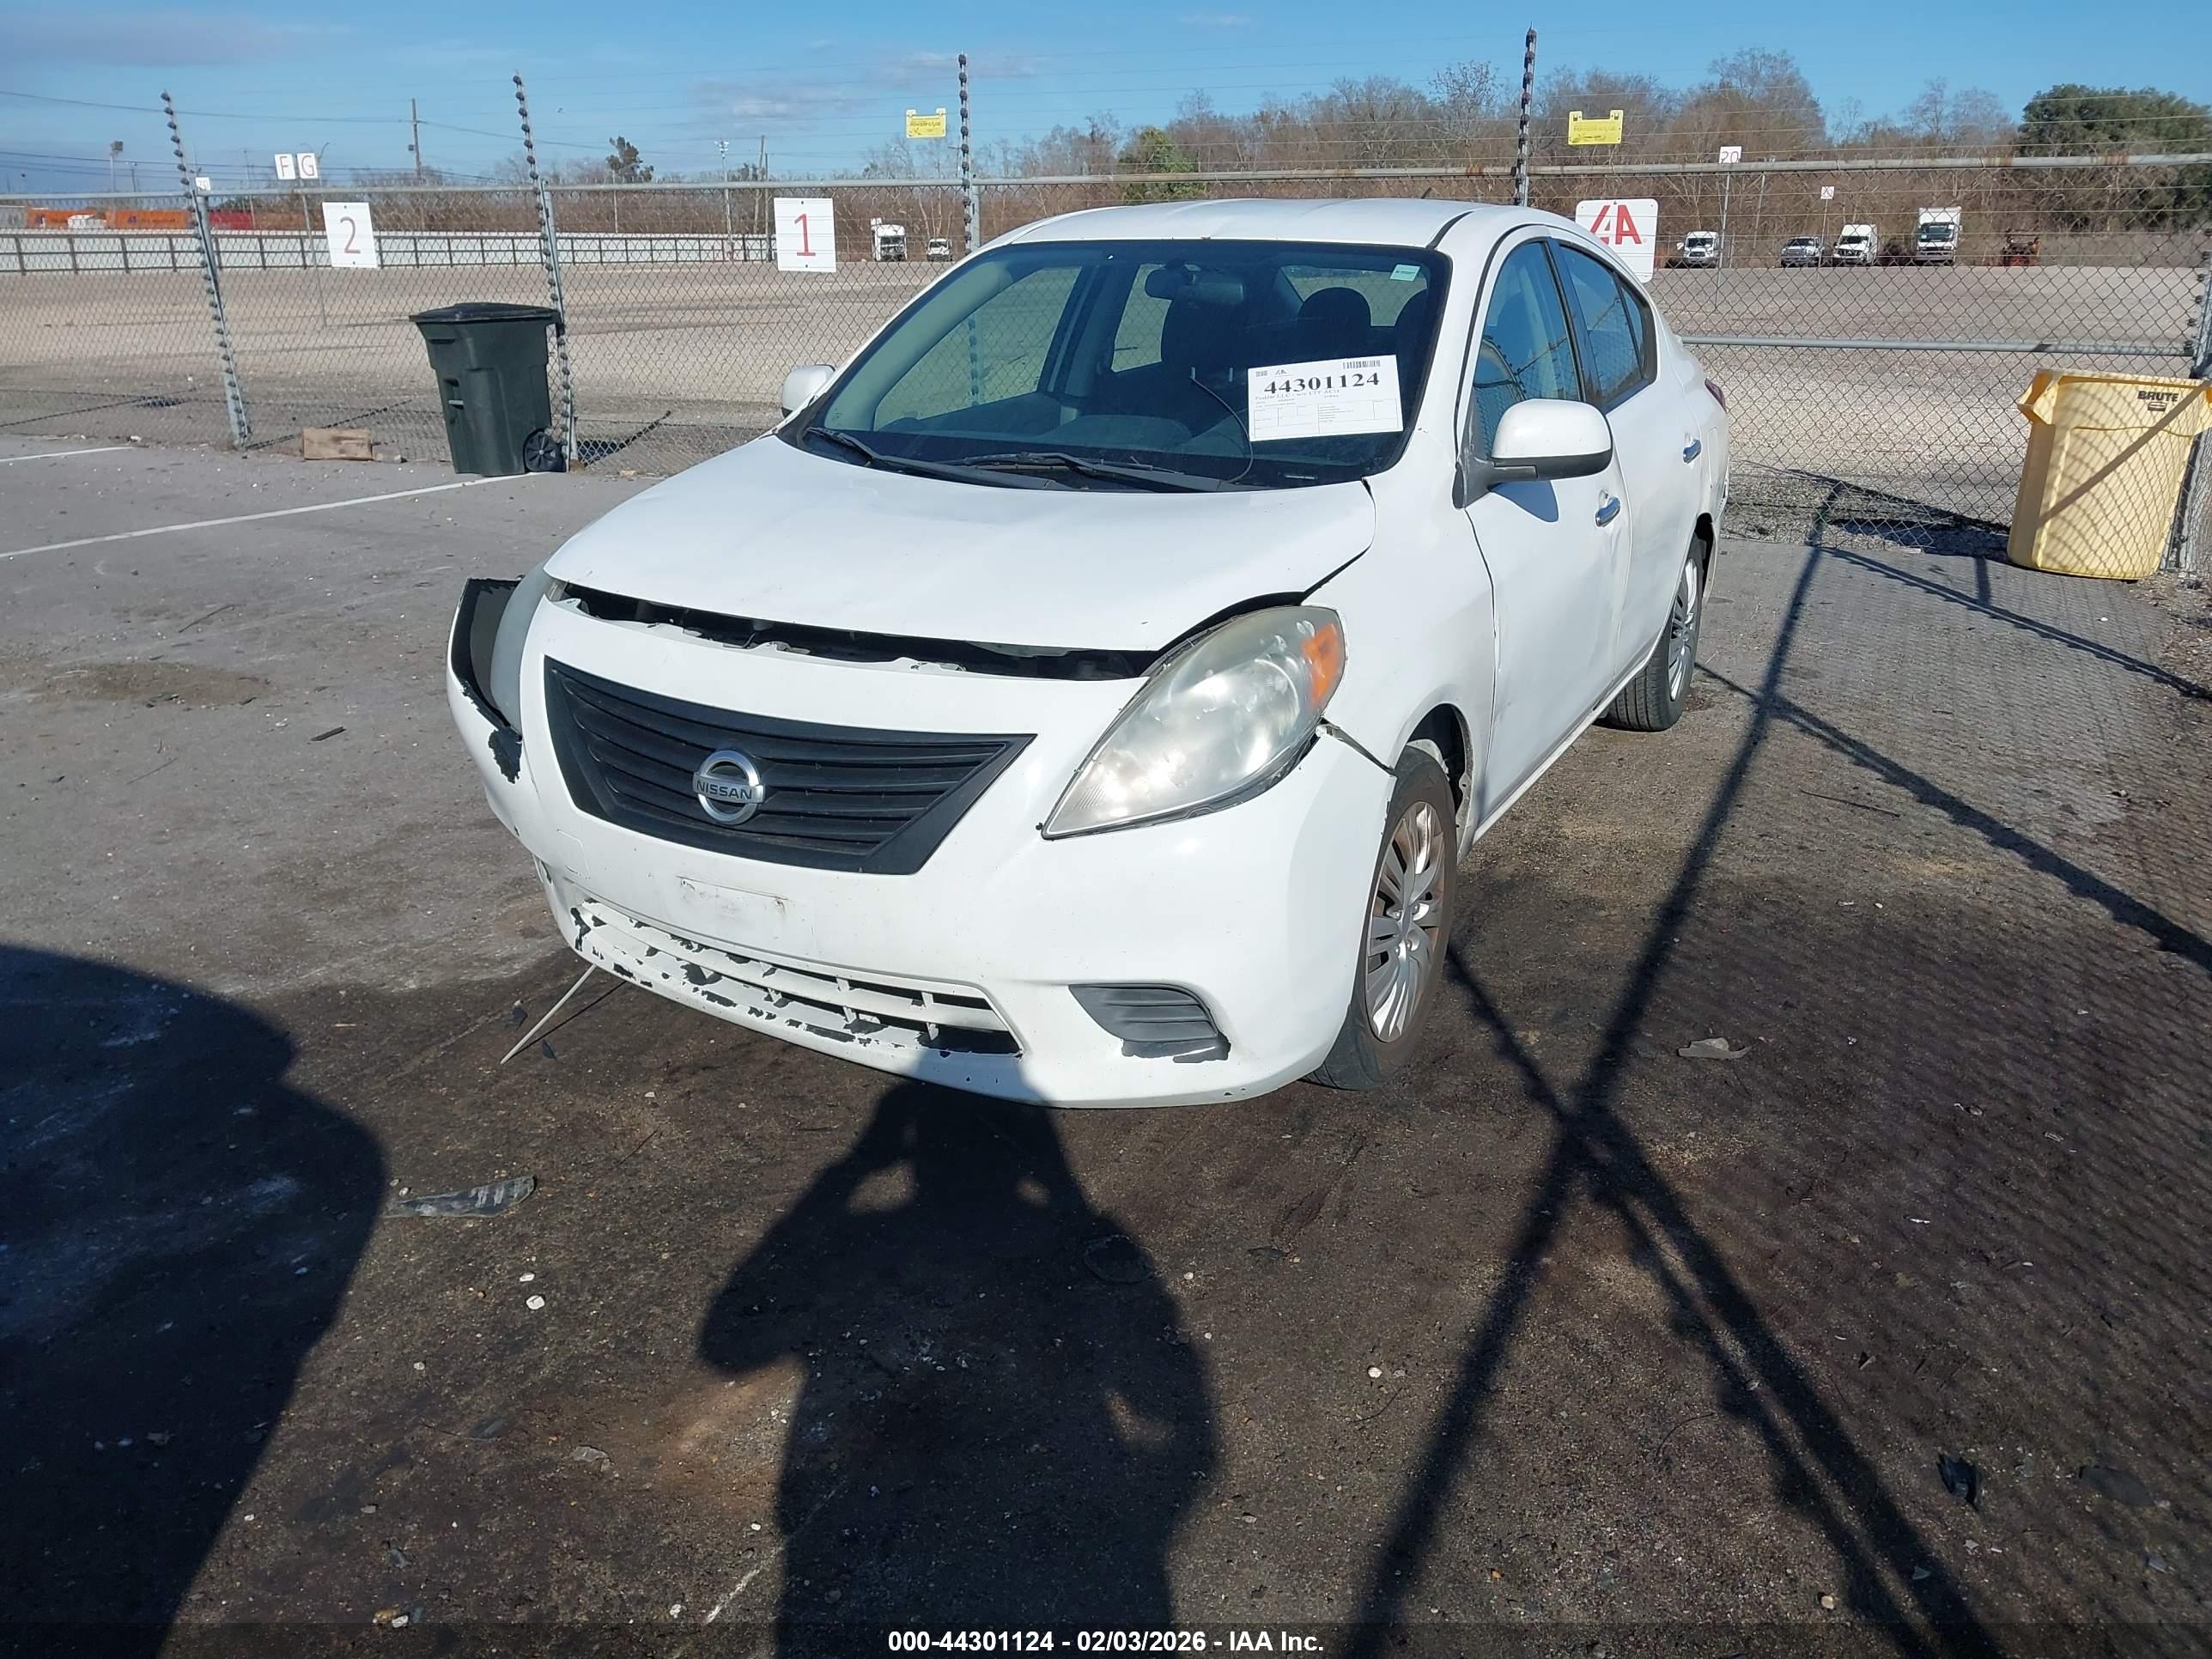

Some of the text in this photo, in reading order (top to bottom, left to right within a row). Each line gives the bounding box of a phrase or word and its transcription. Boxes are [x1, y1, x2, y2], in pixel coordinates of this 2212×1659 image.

[279, 155, 289, 178] F
[301, 155, 315, 177] G
[1721, 151, 1740, 163] 20
[340, 216, 362, 254] 2
[794, 213, 817, 257] 1
[1264, 372, 1381, 395] 44301124
[2137, 390, 2179, 402] BRUTE
[696, 779, 752, 800] NISSAN
